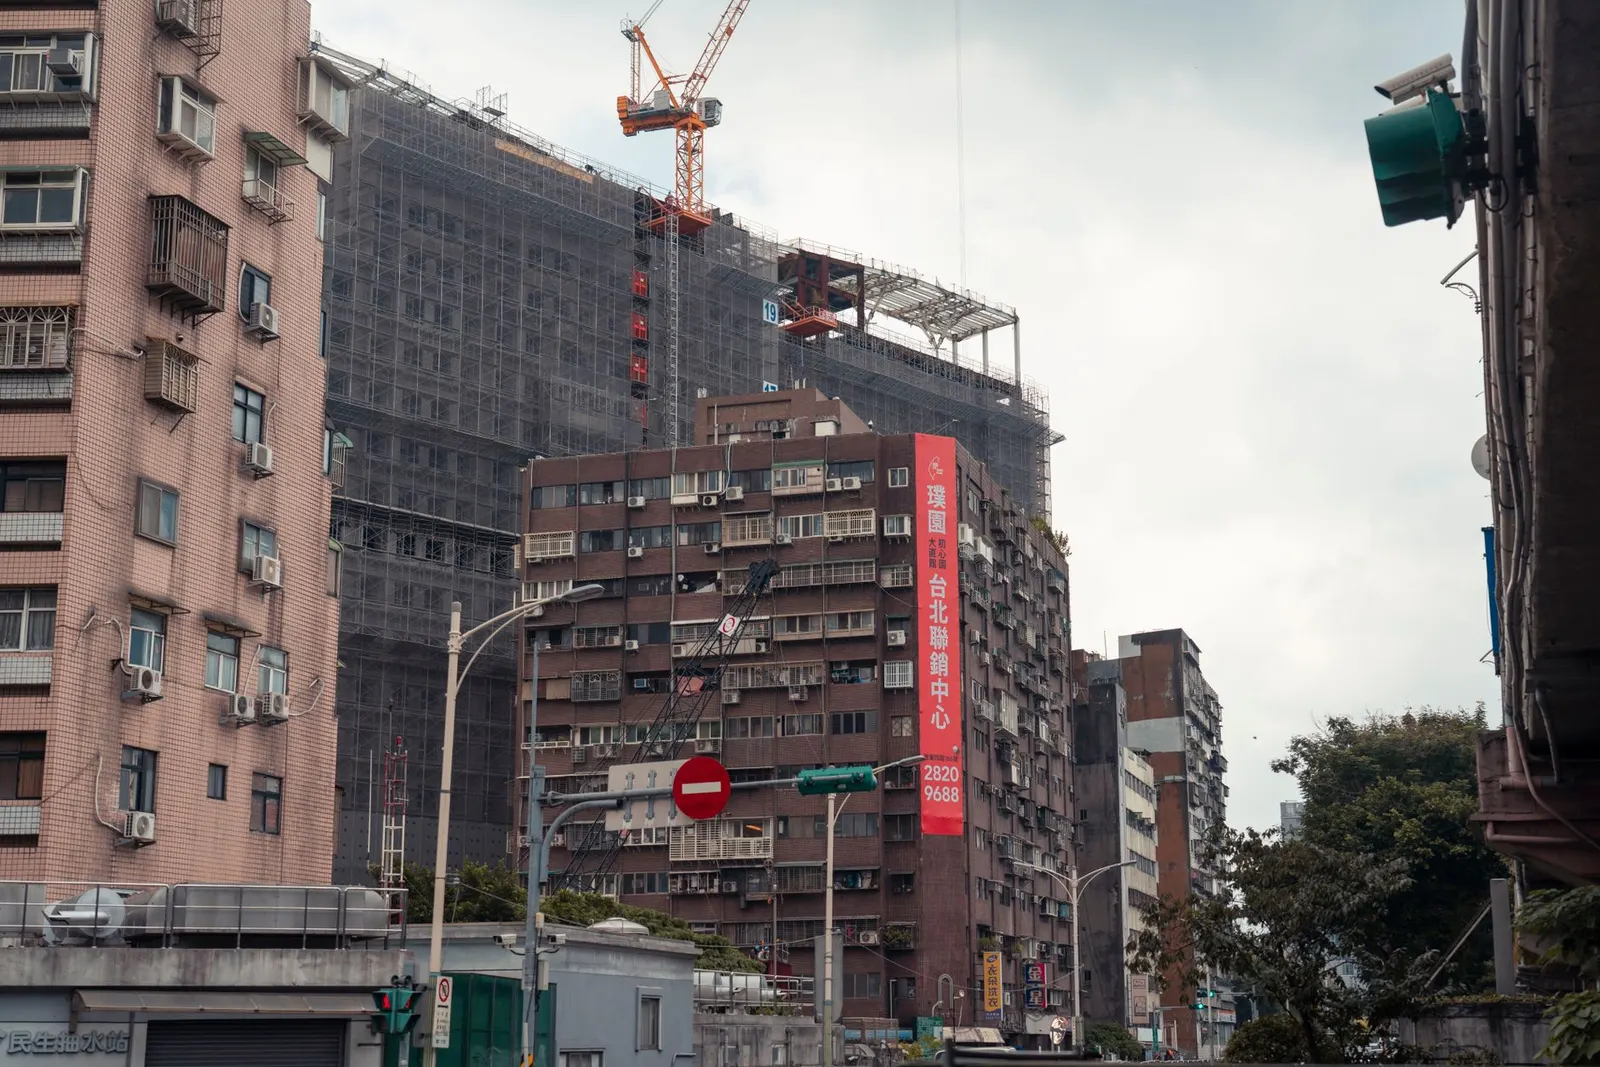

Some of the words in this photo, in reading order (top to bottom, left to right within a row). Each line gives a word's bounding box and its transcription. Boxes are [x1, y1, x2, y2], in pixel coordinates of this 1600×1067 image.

[764, 302, 777, 322] 19
[927, 484, 946, 535] 璞園
[929, 573, 951, 730] 台北聯銷中心
[924, 764, 959, 782] 2820
[924, 785, 959, 803] 9688
[1027, 966, 1043, 1006] 金星
[0, 1029, 130, 1054] 民生抽水站
